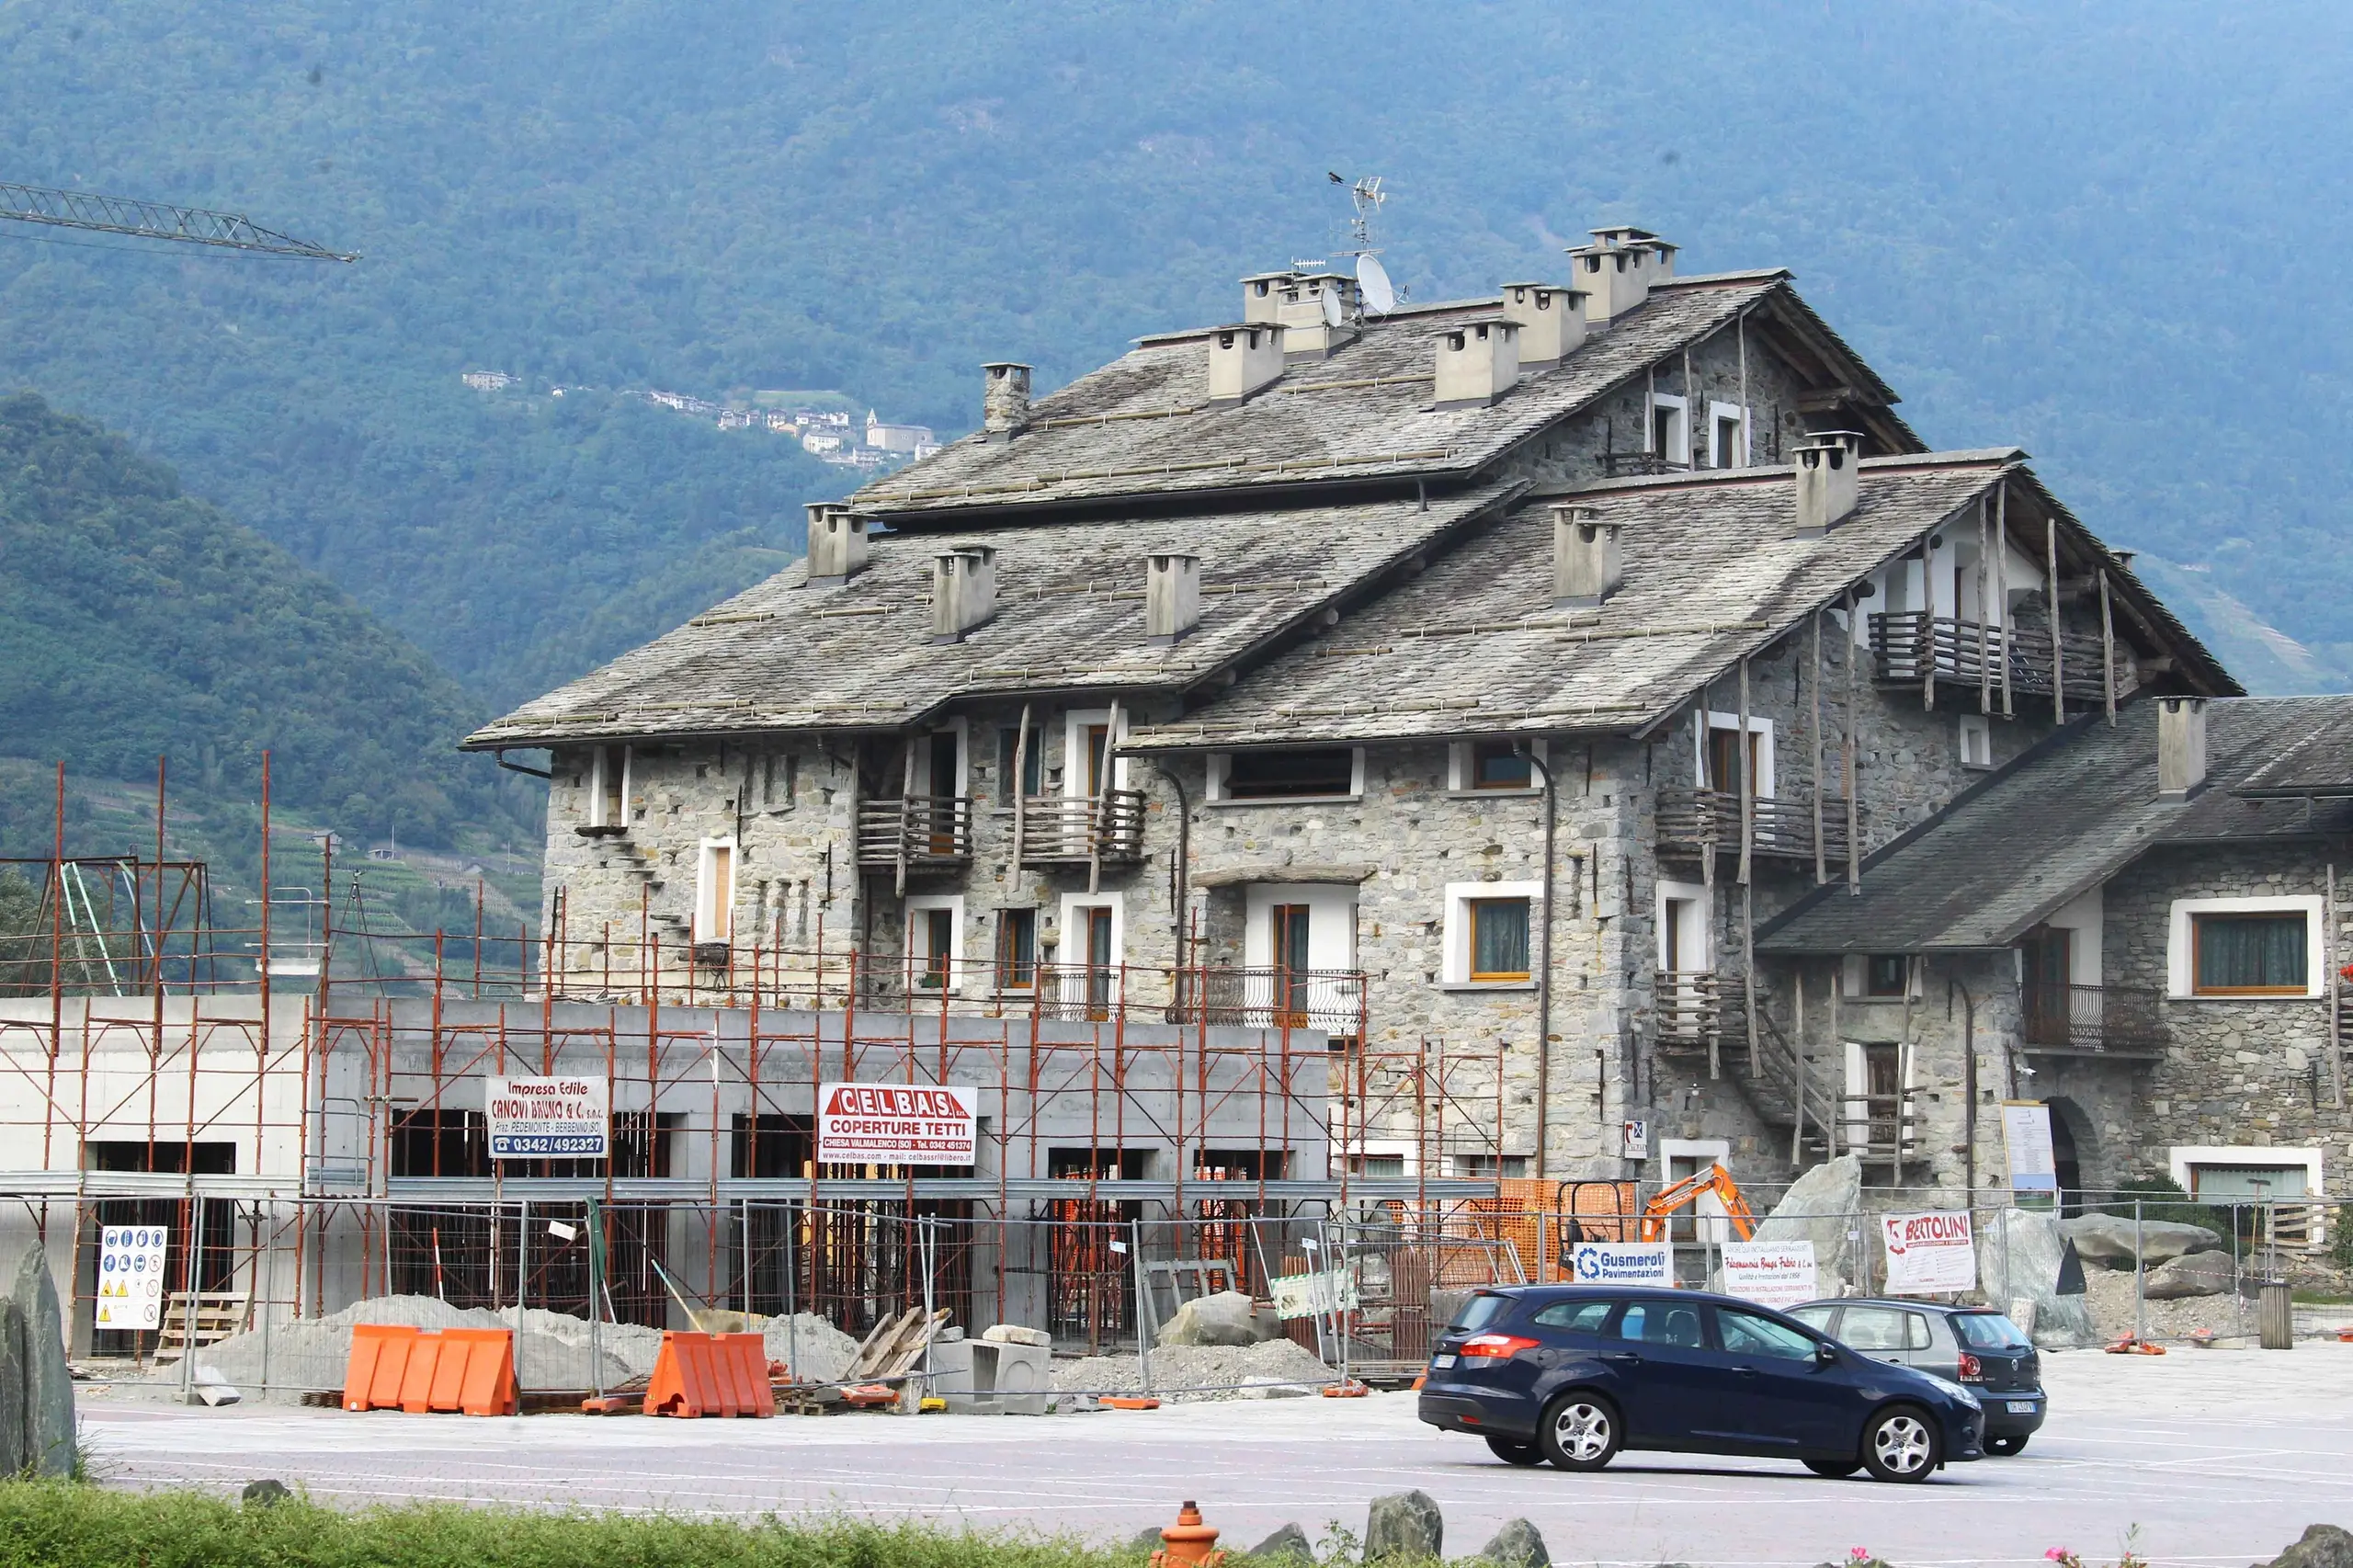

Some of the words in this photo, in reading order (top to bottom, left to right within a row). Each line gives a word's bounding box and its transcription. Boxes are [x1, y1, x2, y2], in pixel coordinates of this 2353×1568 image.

[508, 1081, 555, 1097] Impresa
[560, 1082, 587, 1095] Edile
[492, 1100, 528, 1119] CANOVI
[531, 1100, 563, 1119] BRUNO
[566, 1104, 573, 1119] &
[576, 1100, 584, 1119] C.
[841, 1089, 952, 1116] C.E.L.B.A.S.
[510, 1121, 550, 1132] PEDEMONTE
[555, 1122, 587, 1133] BERBENNO
[588, 1122, 601, 1134] (SO)
[830, 1119, 921, 1134] COPERTURE
[926, 1122, 965, 1136] TETTI
[513, 1137, 601, 1152] 0342/492327
[824, 1138, 849, 1147] CHIESA
[851, 1139, 896, 1149] VALMALENCO
[897, 1140, 911, 1150] (SO)
[917, 1141, 928, 1149] Tel.
[929, 1141, 945, 1149] 0342
[947, 1142, 971, 1150] 451374
[823, 1151, 881, 1160] www.celbas.com
[889, 1153, 906, 1161] mail:
[908, 1153, 971, 1162] celbassrl@libero.it
[1601, 1252, 1665, 1267] Gusmeroli
[1603, 1267, 1664, 1278] Pavimentazioni
